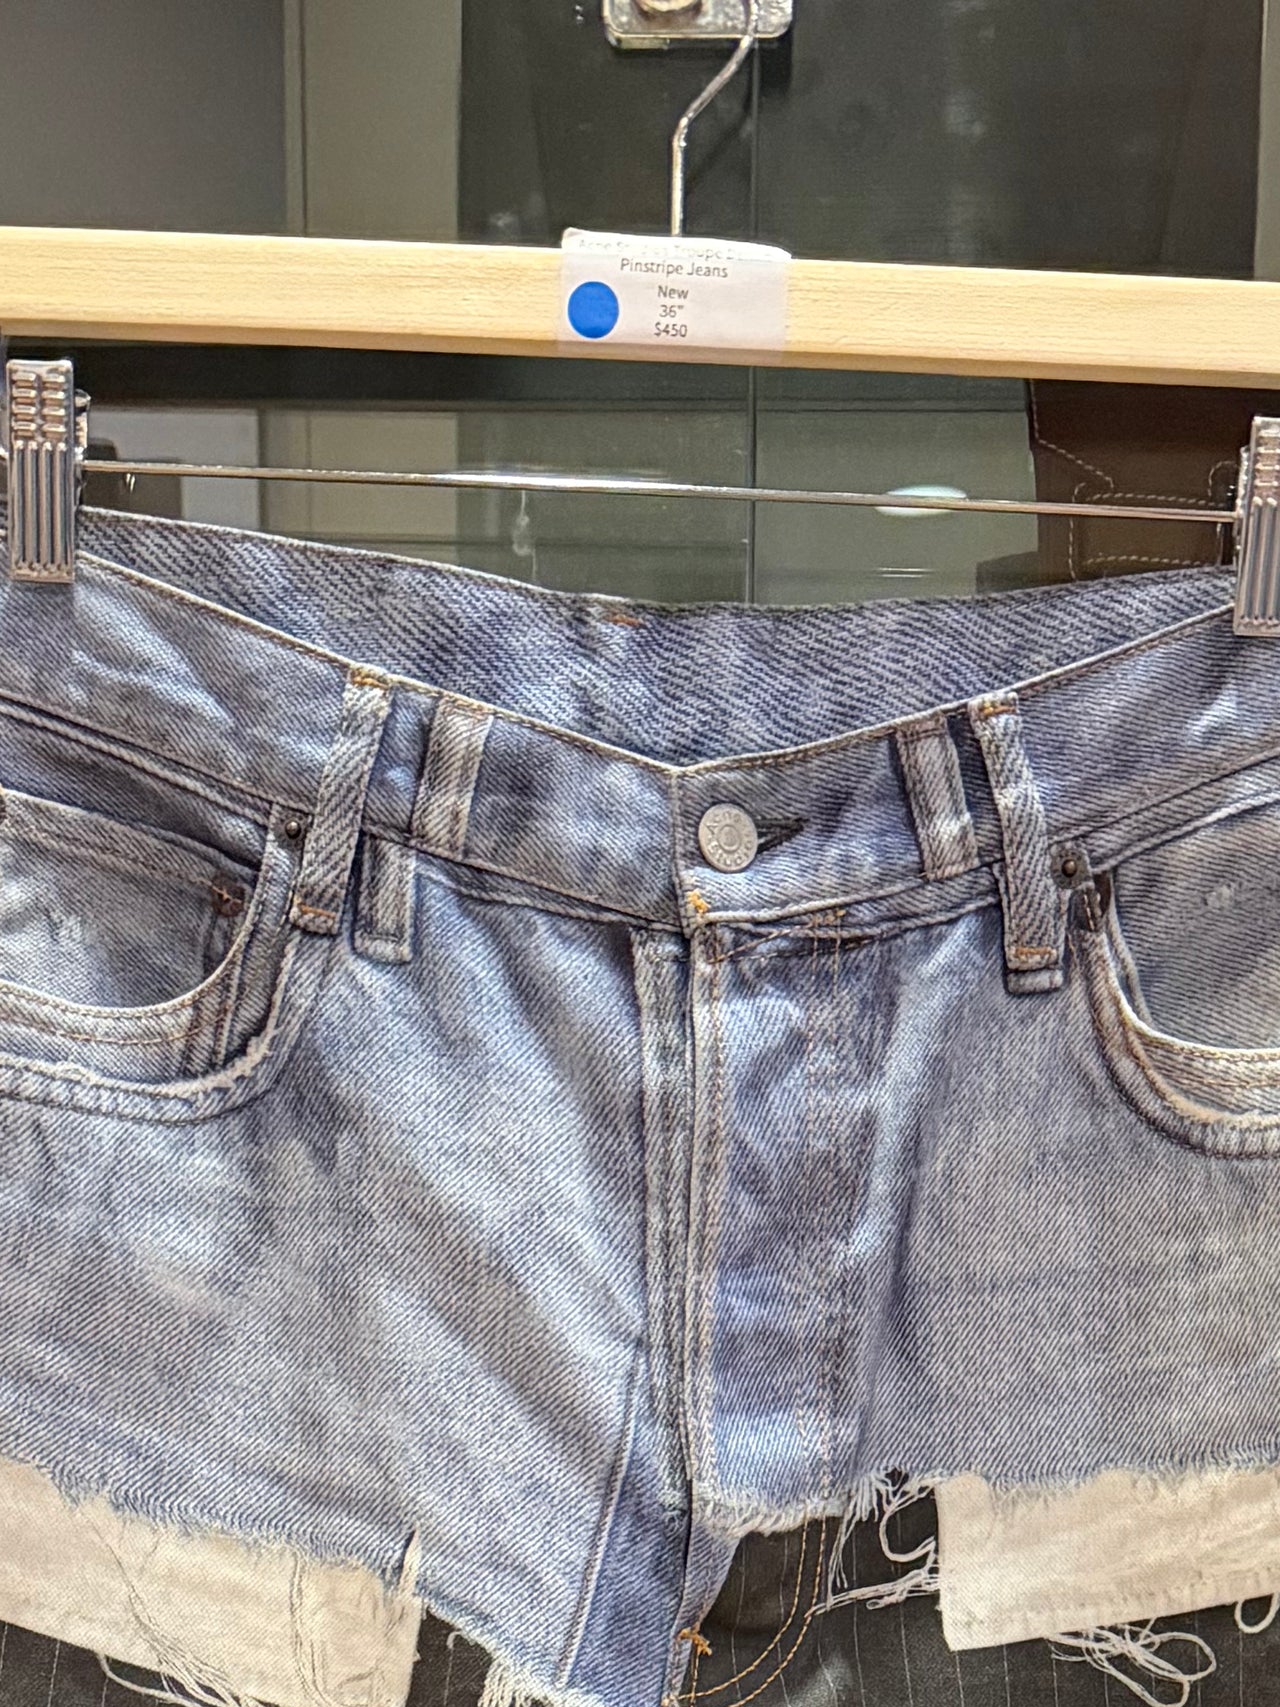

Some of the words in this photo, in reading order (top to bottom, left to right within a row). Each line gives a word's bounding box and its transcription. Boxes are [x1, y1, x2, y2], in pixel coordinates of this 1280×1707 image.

[620, 258, 684, 278] Pinstripe
[686, 261, 729, 279] Jeans
[657, 285, 689, 299] New
[654, 321, 688, 338] $450
